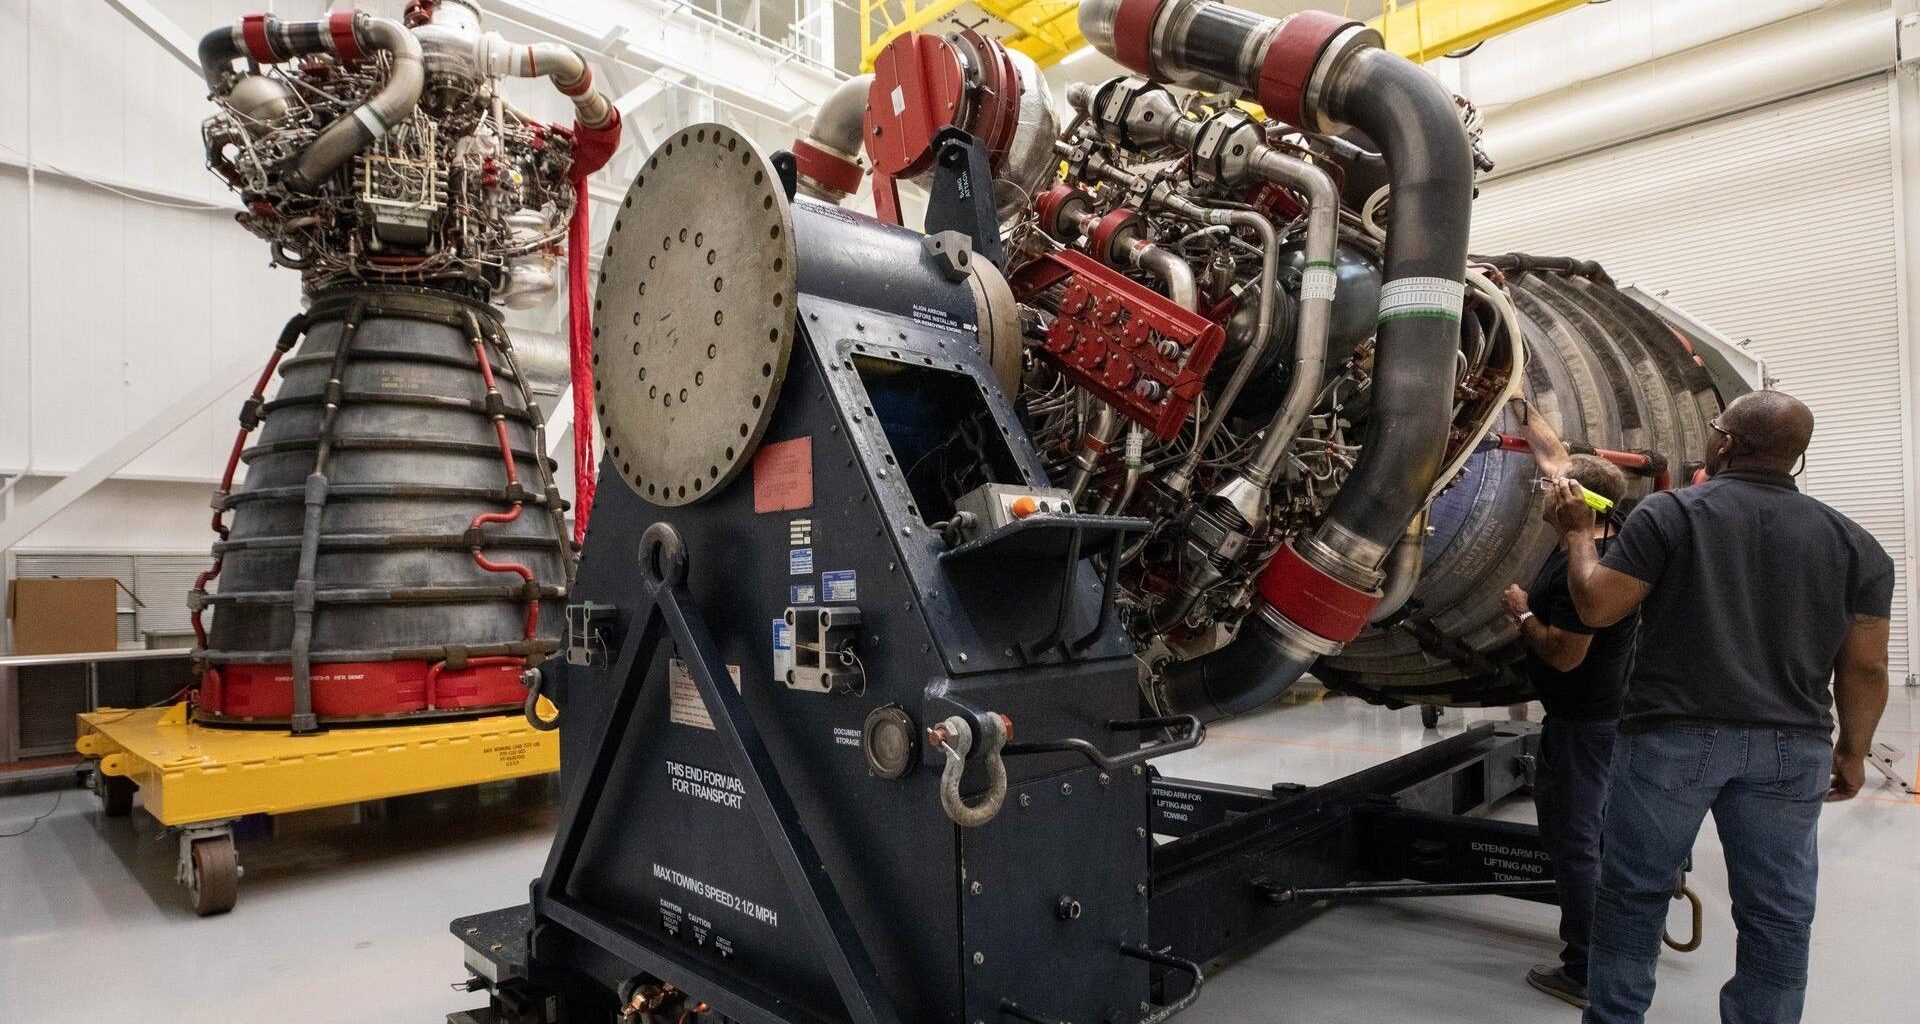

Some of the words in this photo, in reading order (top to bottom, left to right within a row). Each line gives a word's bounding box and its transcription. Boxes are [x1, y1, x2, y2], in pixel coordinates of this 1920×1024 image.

[912, 304, 927, 312] ALIGN
[927, 308, 947, 317] ARROWS
[912, 310, 932, 320] BEFORE
[932, 316, 958, 327] INSTALLING
[921, 320, 945, 330] REMOVING
[833, 727, 862, 737] DOCUMENT
[835, 737, 860, 746] STORAGE
[666, 761, 685, 777] THIS
[685, 765, 702, 782] END
[672, 777, 690, 794] FOR
[690, 782, 742, 809] TRANSPORT
[1151, 787, 1173, 797] XTEND
[1173, 791, 1188, 800] ARM
[1156, 799, 1180, 809] LIFTING
[1180, 803, 1194, 811] AND
[1163, 811, 1188, 821] TOWING
[1471, 842, 1509, 855] EXTEND
[1510, 847, 1533, 859] ARM
[1534, 850, 1551, 861] FO
[1483, 857, 1520, 870] LIFTING
[1520, 863, 1542, 874] AND
[653, 862, 671, 882] MAX
[671, 870, 704, 895] TOWING
[704, 884, 734, 907] SPEED
[734, 896, 741, 911] 2
[741, 900, 755, 917] 1/2
[755, 904, 777, 927] MPH
[660, 898, 682, 914] CAUTION
[687, 912, 711, 929] CAUTION
